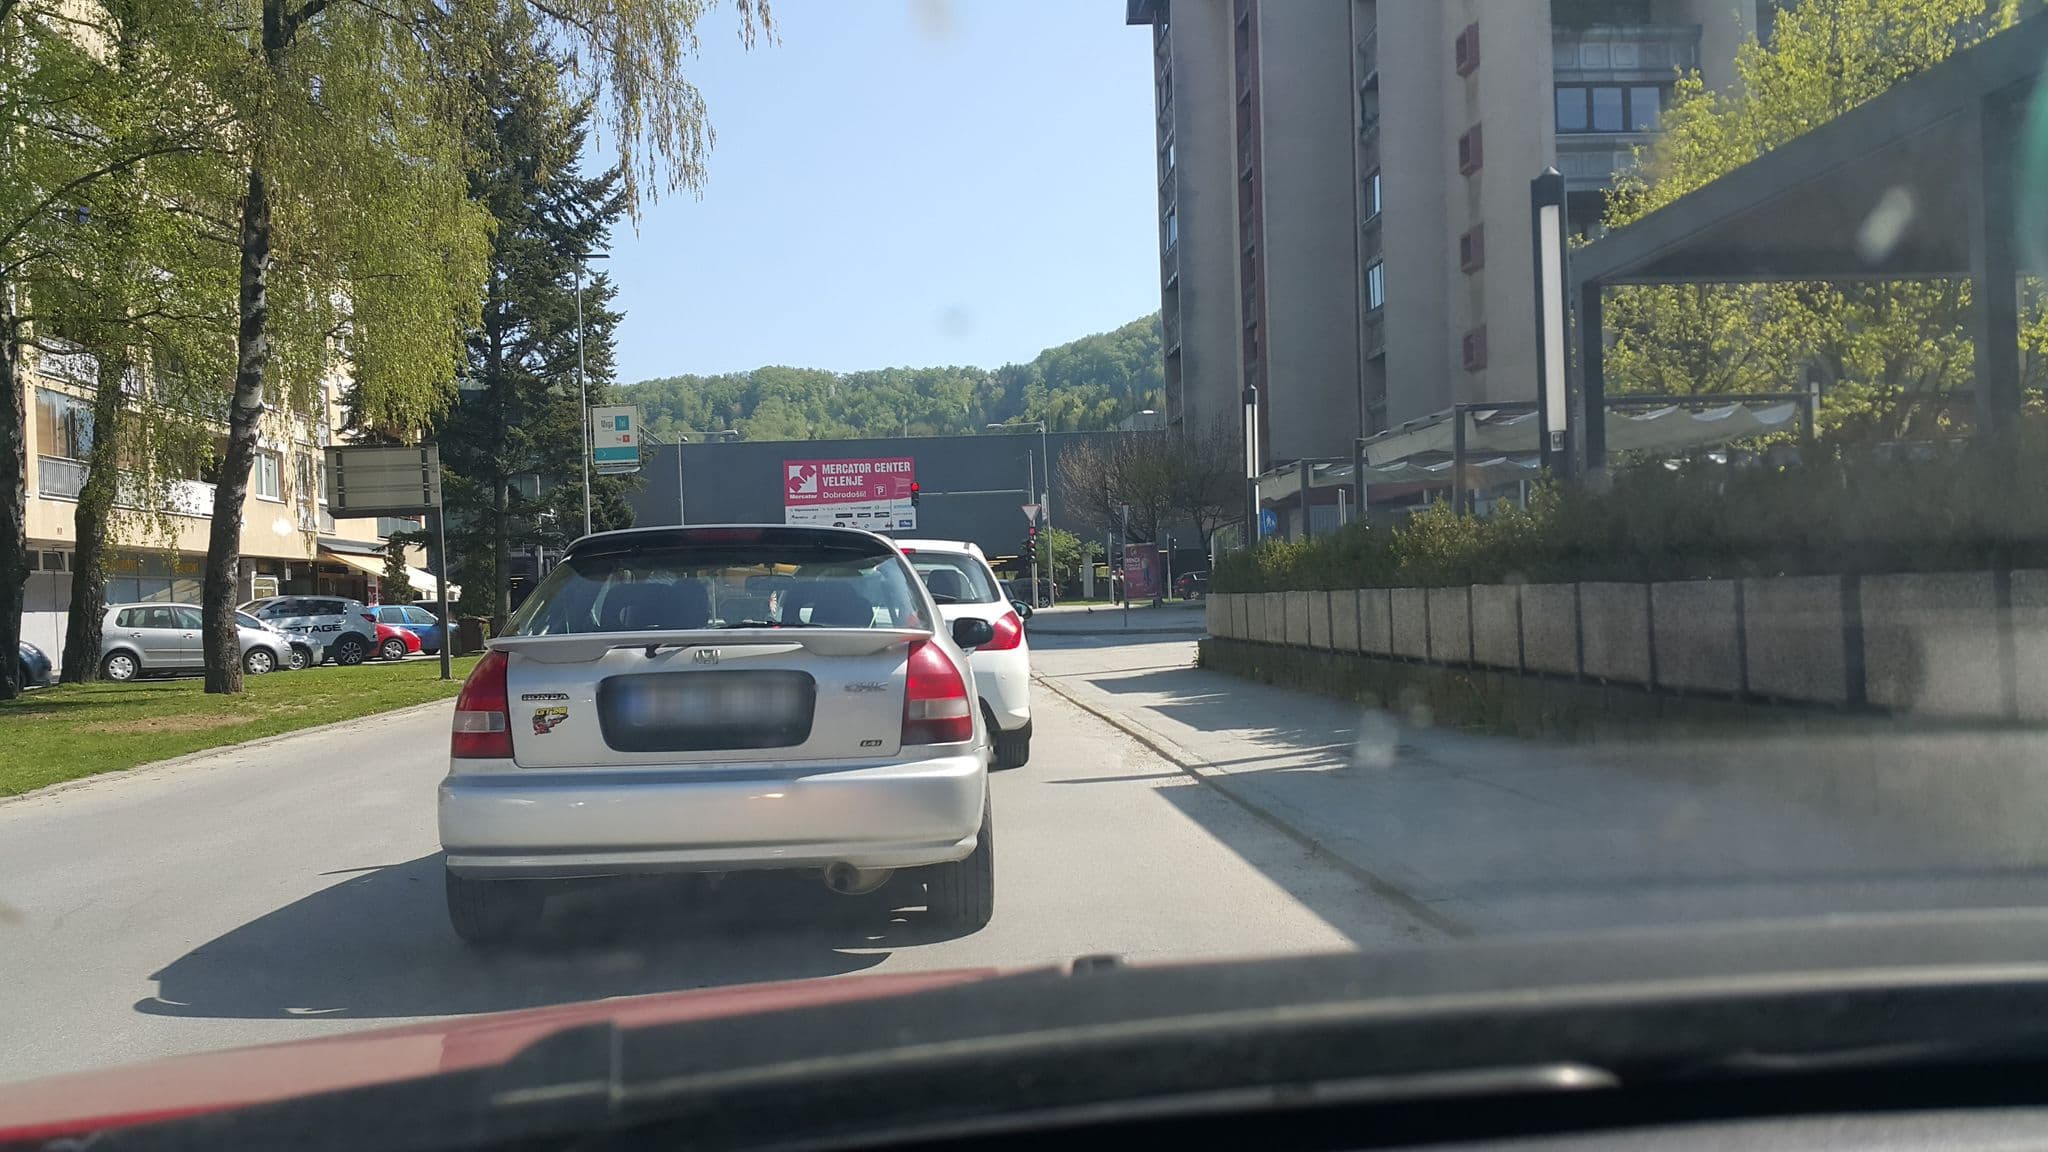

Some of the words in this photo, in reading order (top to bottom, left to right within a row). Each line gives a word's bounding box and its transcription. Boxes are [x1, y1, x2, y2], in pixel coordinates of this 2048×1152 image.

[822, 464, 871, 475] MERCATOR
[874, 462, 911, 473] CENTER
[822, 476, 864, 486] VELENJE
[522, 693, 569, 701] HONDA
